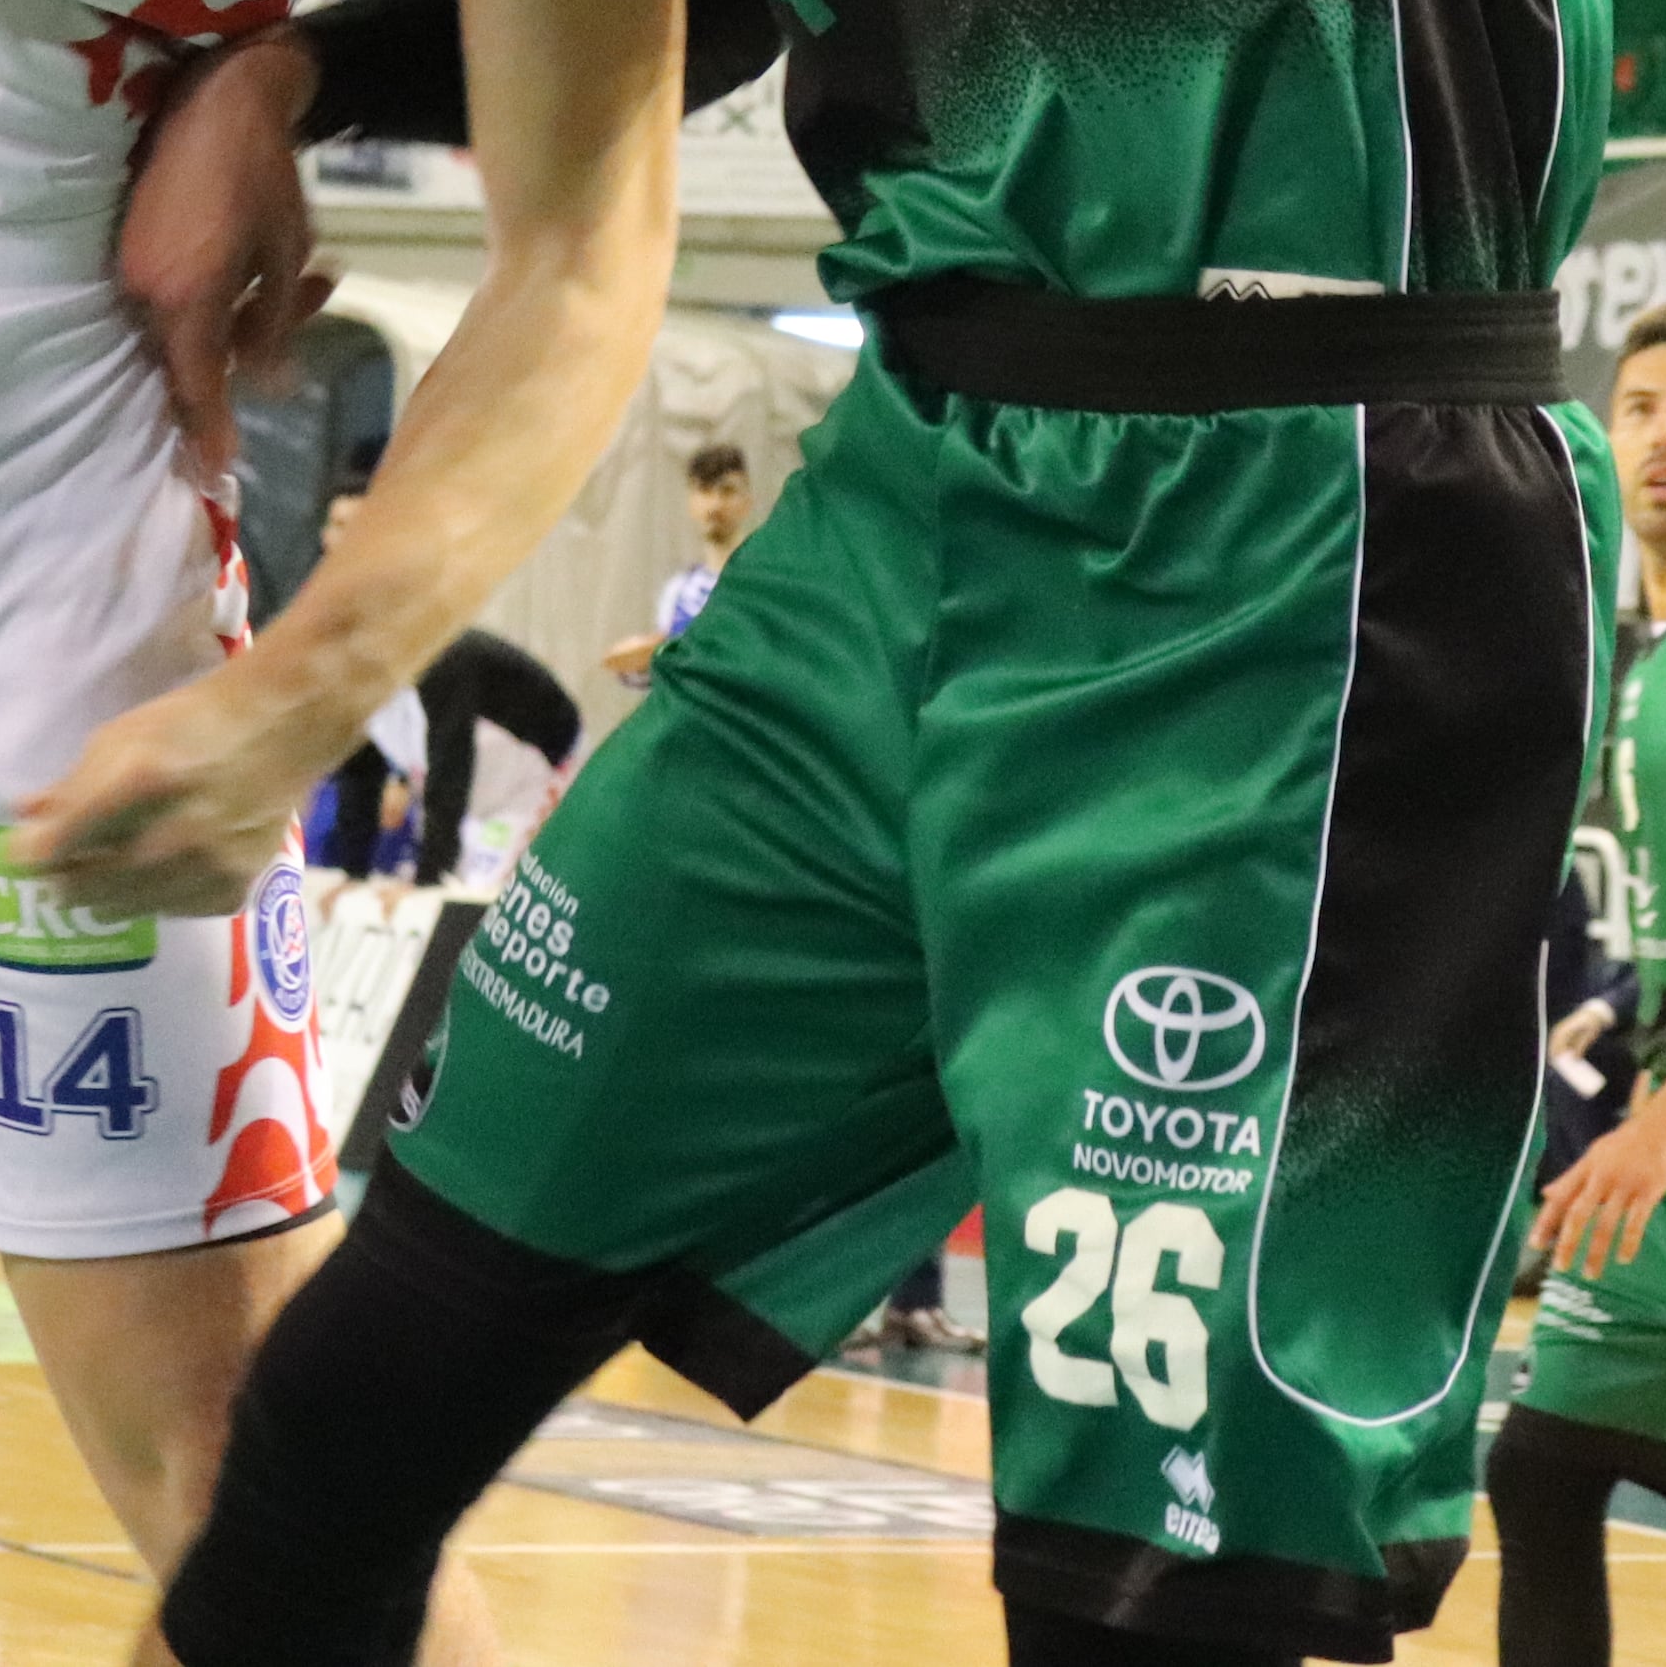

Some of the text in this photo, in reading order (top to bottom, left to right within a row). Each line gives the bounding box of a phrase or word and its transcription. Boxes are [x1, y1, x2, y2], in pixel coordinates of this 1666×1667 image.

[1083, 1089, 1261, 1157] TOYOTA
[1073, 1143, 1254, 1195] NOVOMOTOR
[1021, 1187, 1226, 1432] 26
